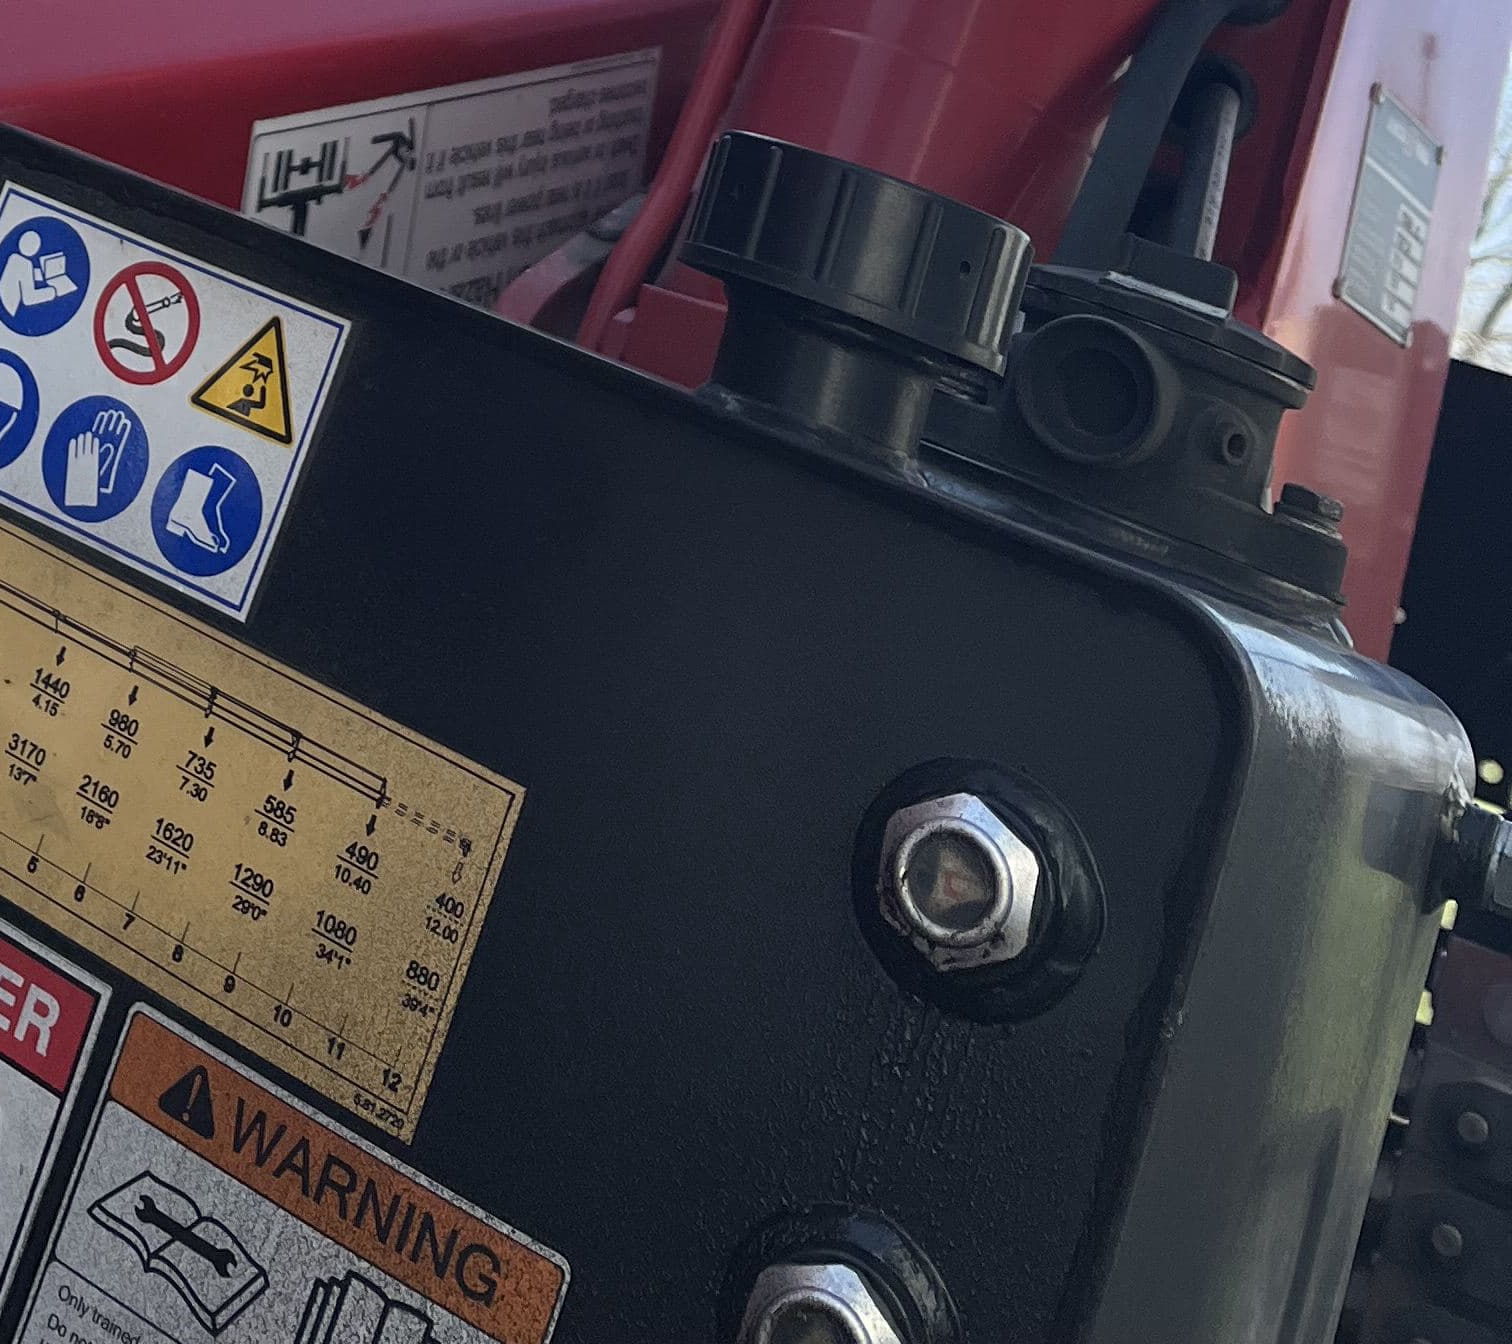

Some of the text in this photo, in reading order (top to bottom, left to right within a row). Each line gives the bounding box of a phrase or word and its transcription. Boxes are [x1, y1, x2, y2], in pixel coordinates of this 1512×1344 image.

[8, 733, 46, 766] 3170
[78, 774, 120, 808] 2160
[154, 817, 194, 852] 1620
[232, 863, 274, 899] 1290
[316, 909, 357, 947] 1080
[405, 960, 440, 992] 880
[31, 694, 60, 717] 4.15
[103, 734, 132, 759] 5.70
[179, 776, 208, 802] 7.30
[257, 822, 288, 847] 8.83
[334, 864, 372, 896] 10.40
[425, 916, 459, 944] 12.00
[34, 667, 71, 699] 1440
[108, 709, 140, 738] 980
[184, 750, 218, 780] 735
[263, 795, 297, 825] 585
[345, 841, 380, 872] 490
[435, 893, 465, 920] 400
[27, 856, 38, 873] 5
[74, 884, 86, 902] 6
[122, 912, 136, 930] 7
[171, 943, 184, 963] 8
[222, 974, 236, 995] 9
[273, 1003, 293, 1028] 10
[327, 1036, 345, 1060] 11
[382, 1067, 403, 1093] 12
[58, 1285, 90, 1319] Only
[232, 1097, 503, 1306] WARNING
[47, 1313, 67, 1338] Do
